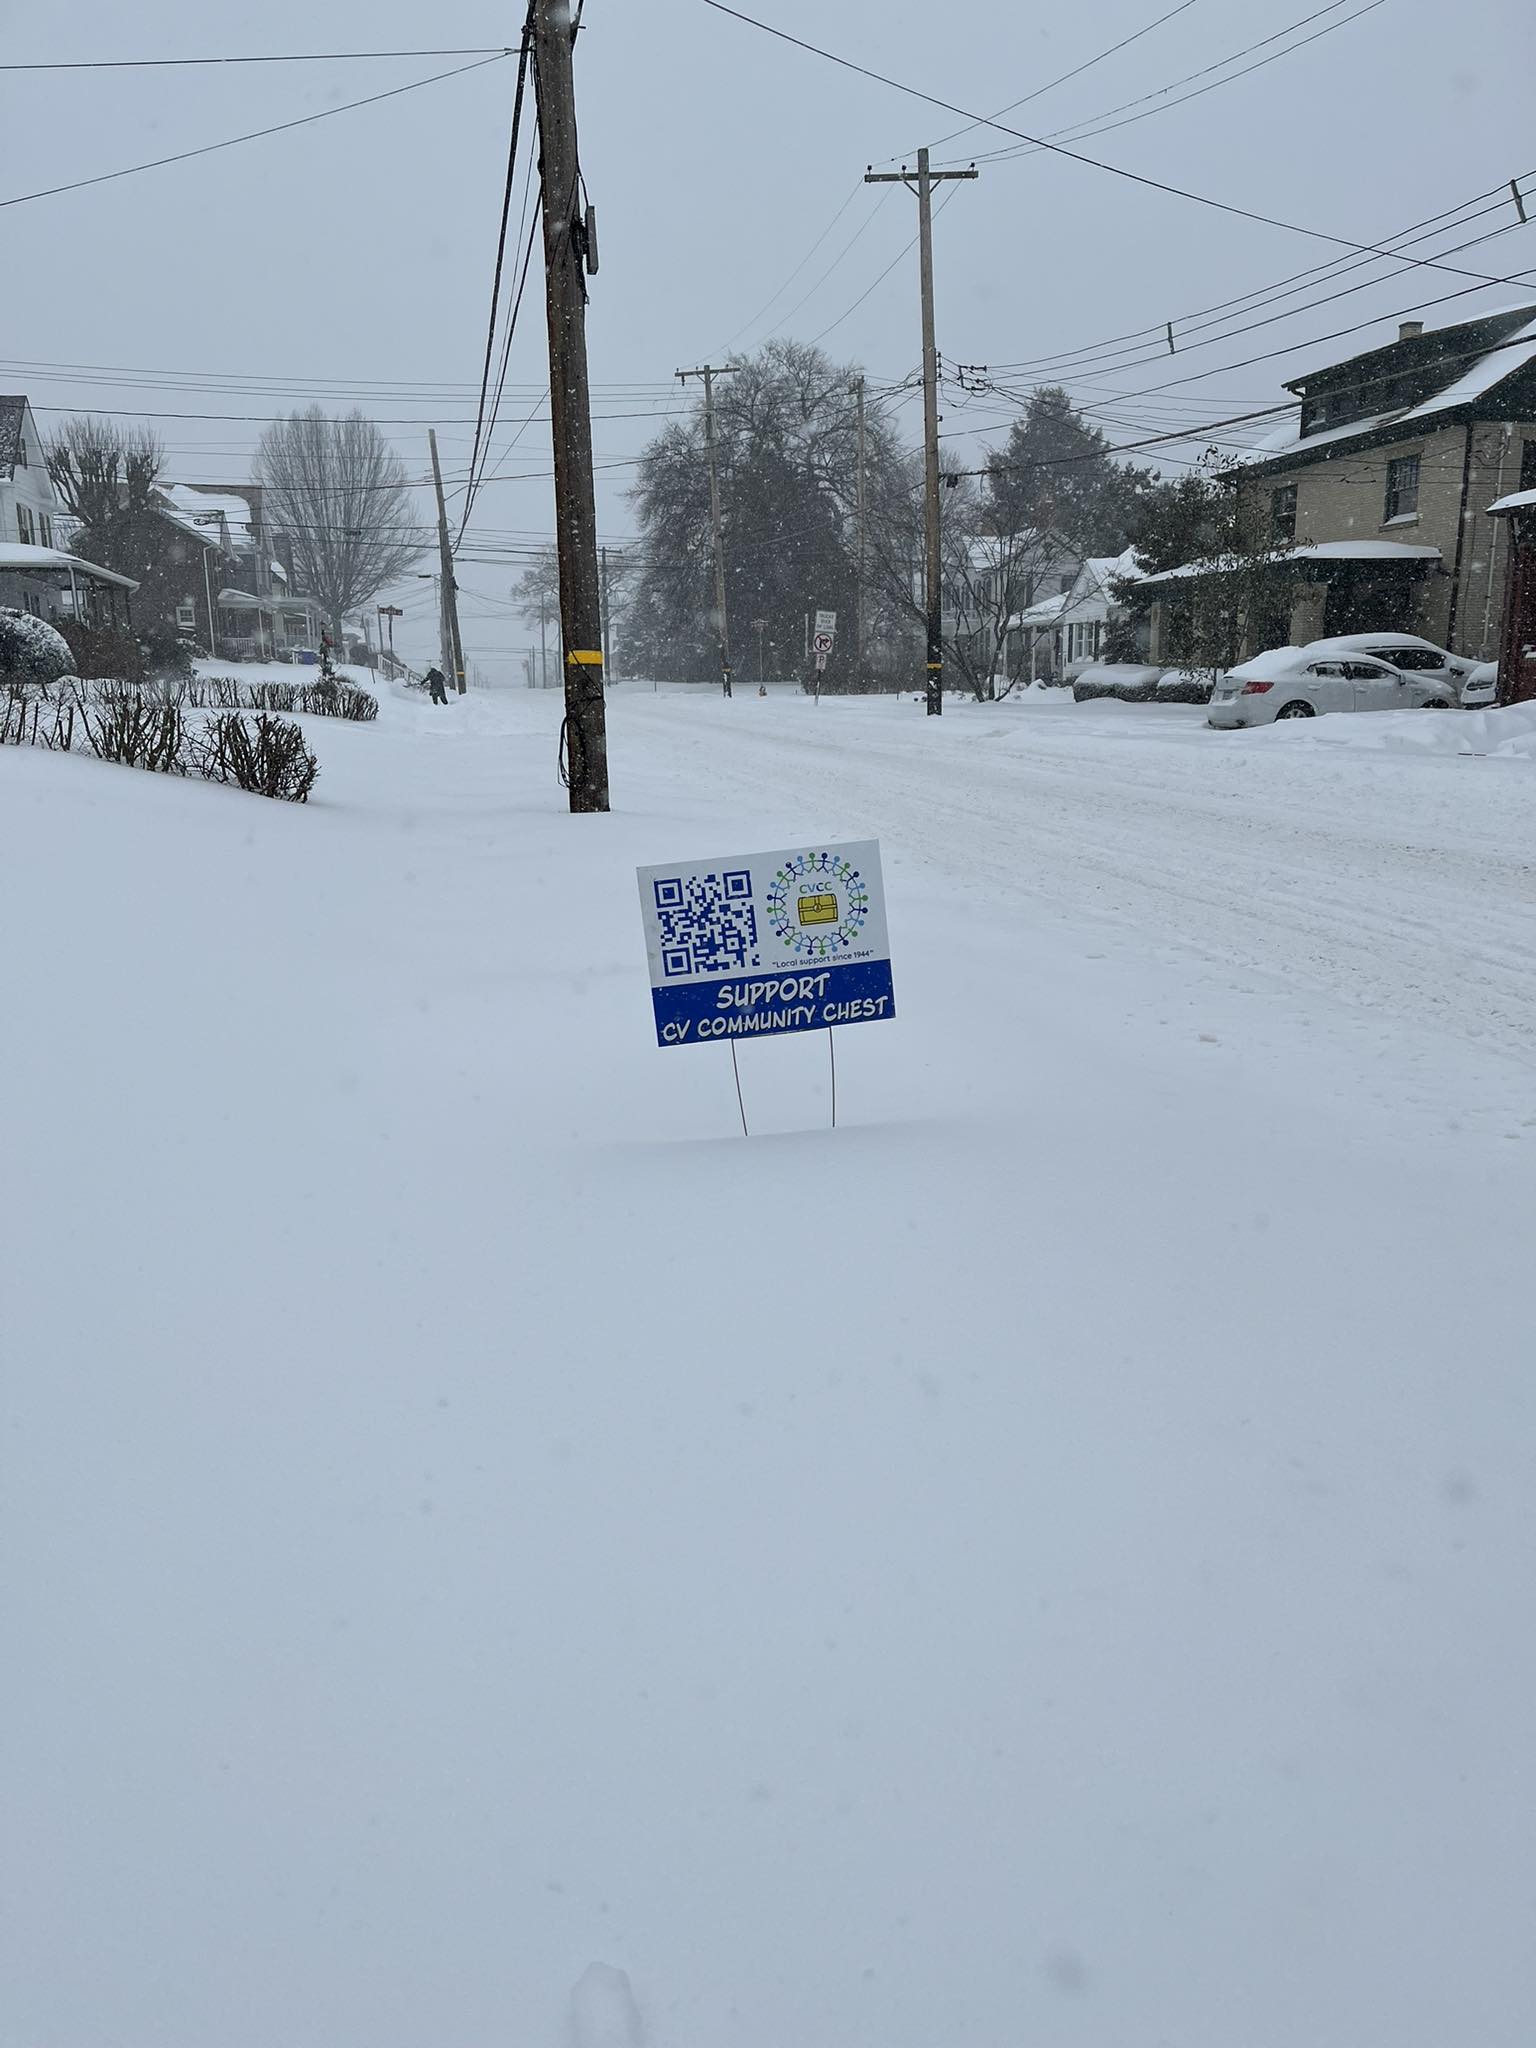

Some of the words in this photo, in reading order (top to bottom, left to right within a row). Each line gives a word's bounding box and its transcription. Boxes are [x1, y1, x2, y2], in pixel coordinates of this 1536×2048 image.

[799, 882, 832, 894] CVCC
[799, 955, 831, 966] support
[832, 954, 852, 962] since
[716, 973, 831, 1008] SUPPORT
[662, 1020, 690, 1041] CV
[698, 1005, 816, 1037] COMMUNITY
[823, 997, 888, 1020] CHEST
